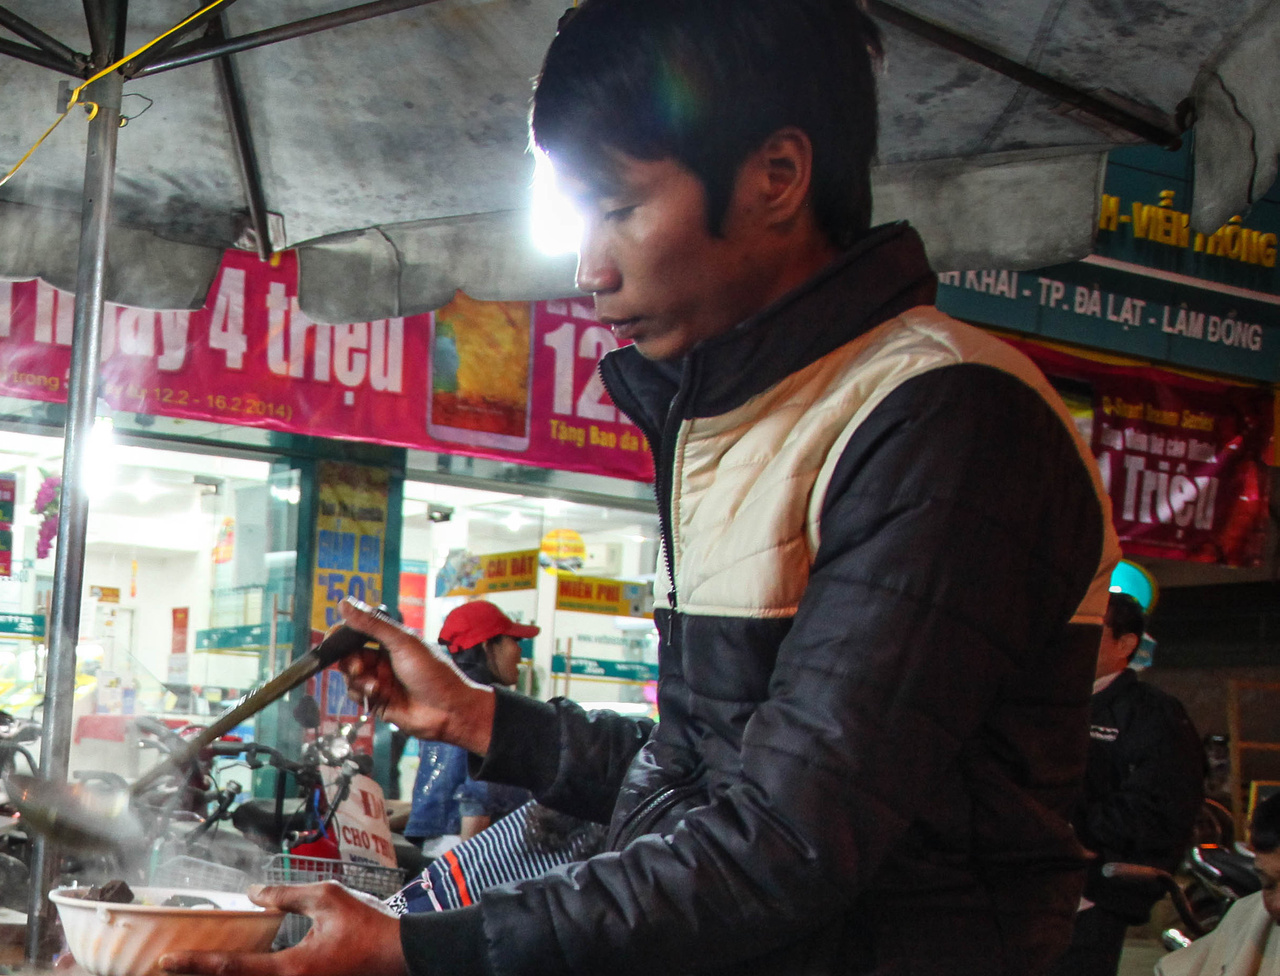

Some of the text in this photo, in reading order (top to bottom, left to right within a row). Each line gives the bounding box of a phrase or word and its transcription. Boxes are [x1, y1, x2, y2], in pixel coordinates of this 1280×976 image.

[209, 267, 247, 370] 4
[965, 270, 1018, 299] KHAI
[1039, 277, 1069, 311] TP.
[1107, 292, 1147, 331] LẠT
[1162, 304, 1204, 340] LÂM
[1207, 309, 1263, 351] ĐỒNG
[13, 370, 60, 391] trong
[154, 388, 189, 405] 12.2
[207, 395, 293, 421] 16.2.2014)
[549, 419, 586, 447] Tặng
[589, 425, 617, 447] Bao
[1122, 454, 1219, 540] Triệu
[342, 825, 371, 850] CHO
